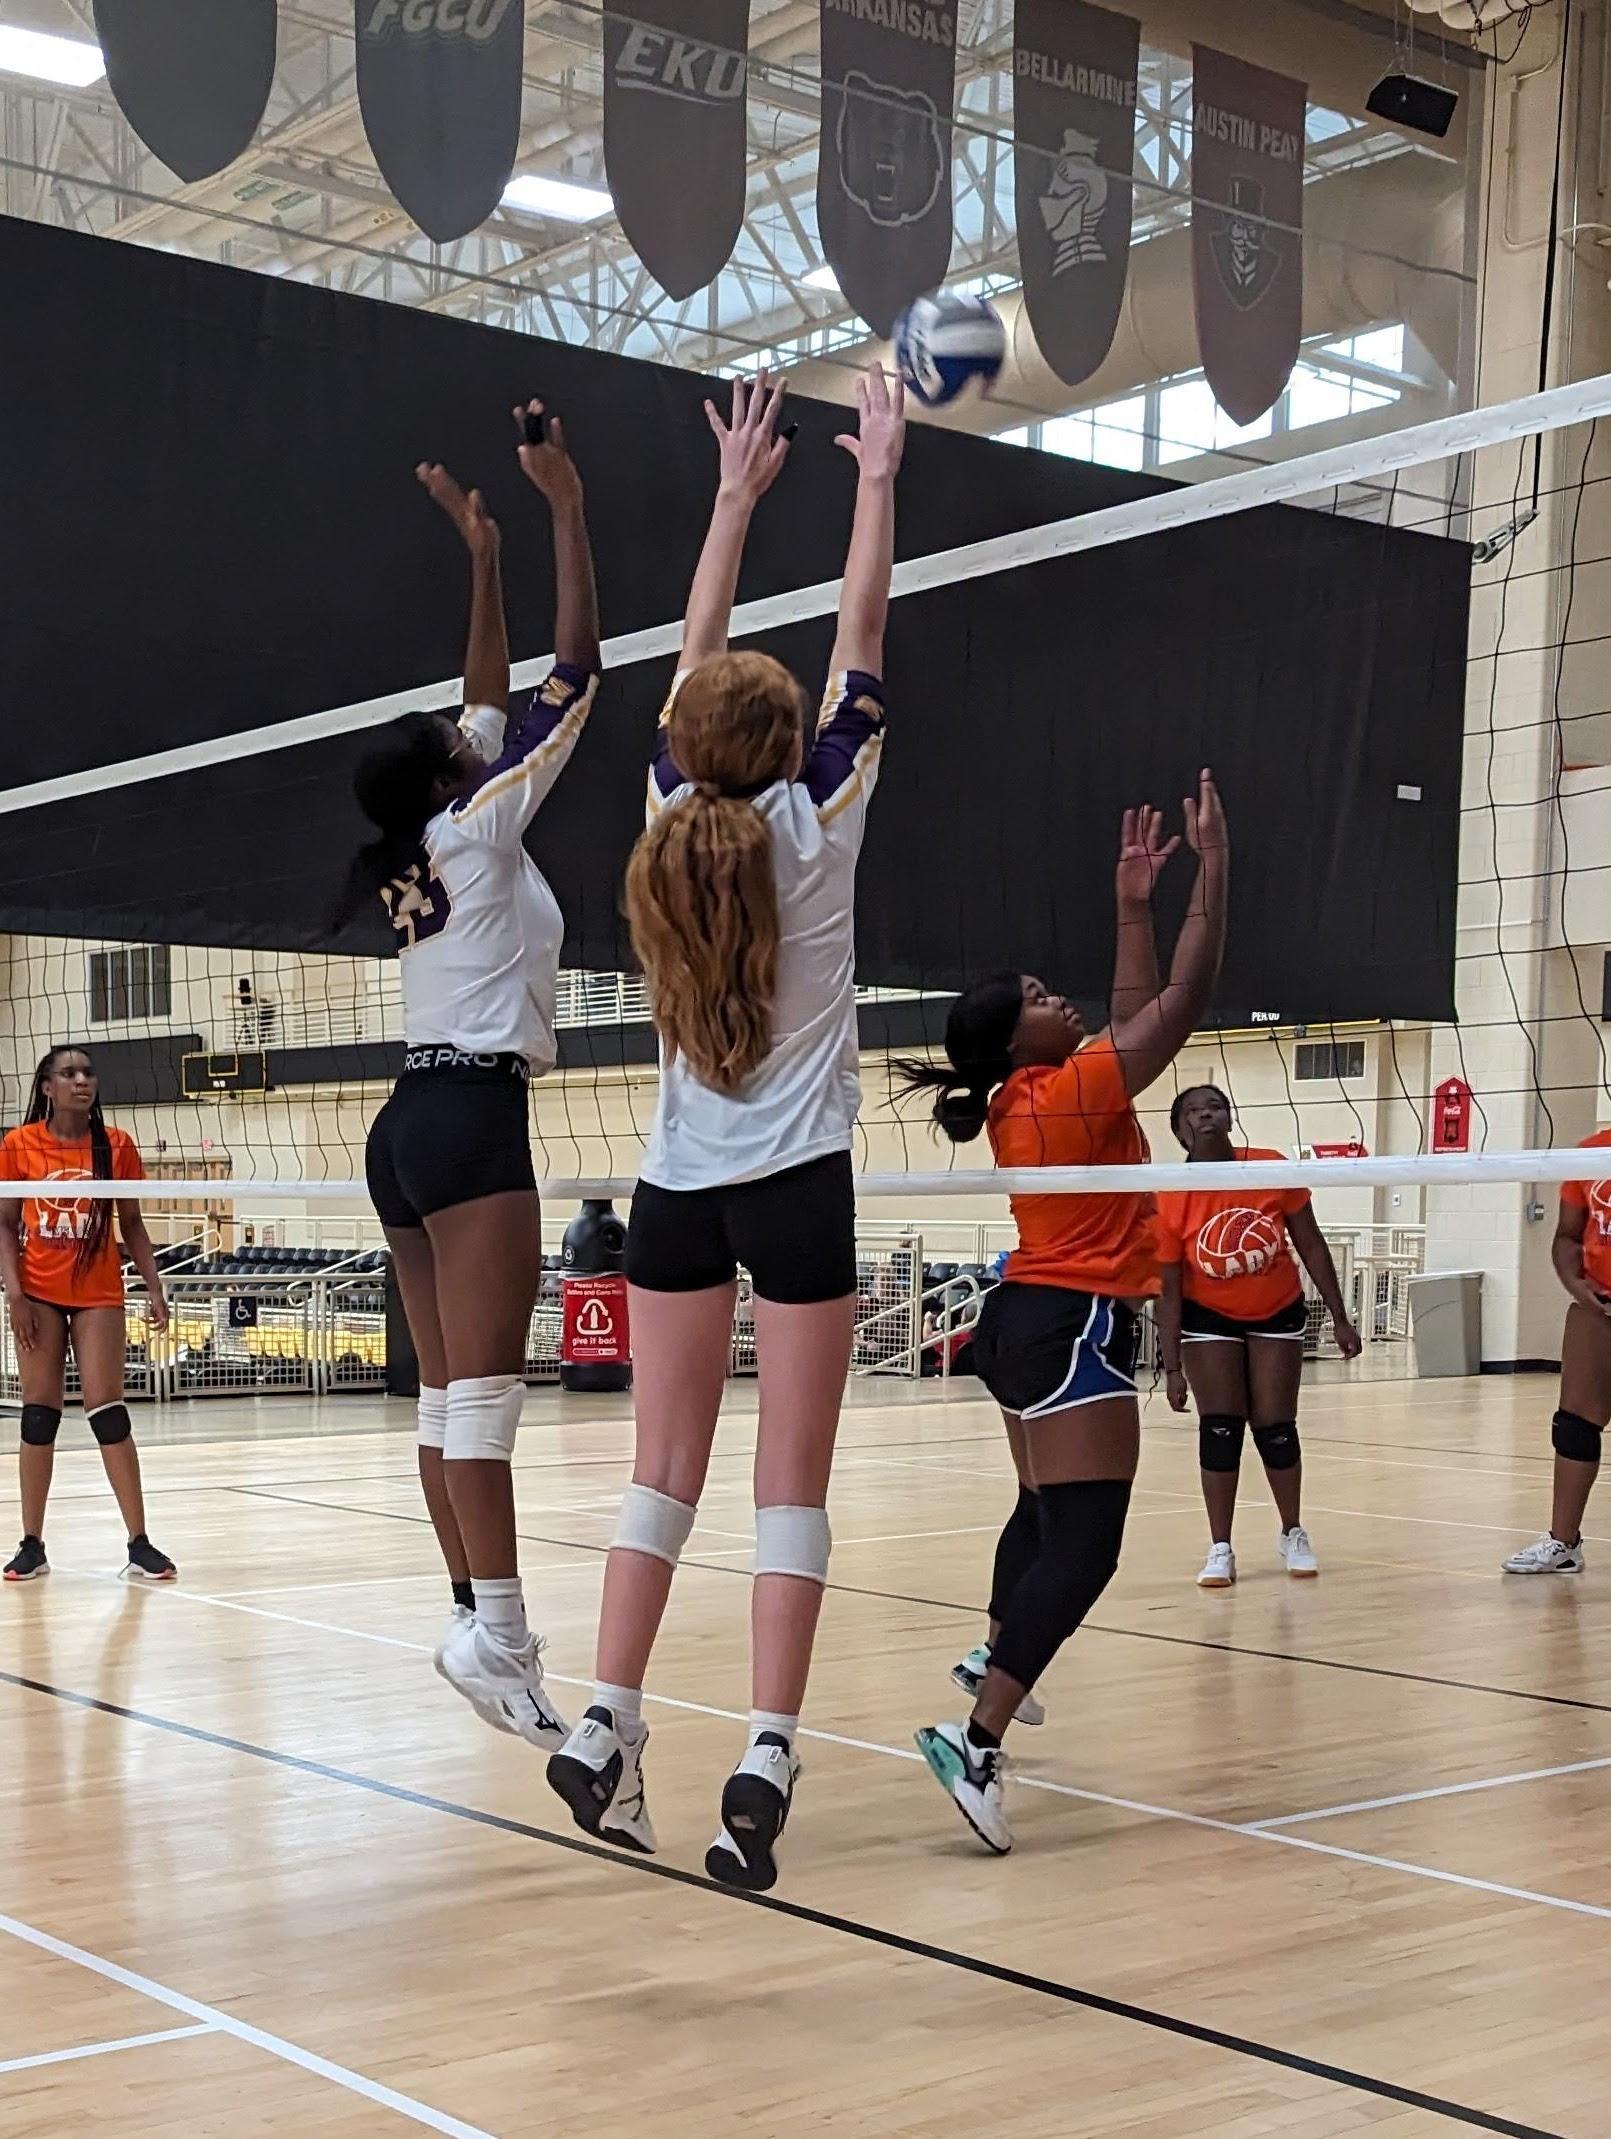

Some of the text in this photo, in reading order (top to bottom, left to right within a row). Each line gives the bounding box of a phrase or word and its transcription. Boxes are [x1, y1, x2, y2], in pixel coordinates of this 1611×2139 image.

[824, 0, 953, 47] KANSAS
[1015, 48, 1136, 106] BELLARMINE
[1195, 101, 1299, 161] AUSTIN PEAY
[435, 1049, 498, 1067] PRO
[572, 1336, 616, 1346] give it back
